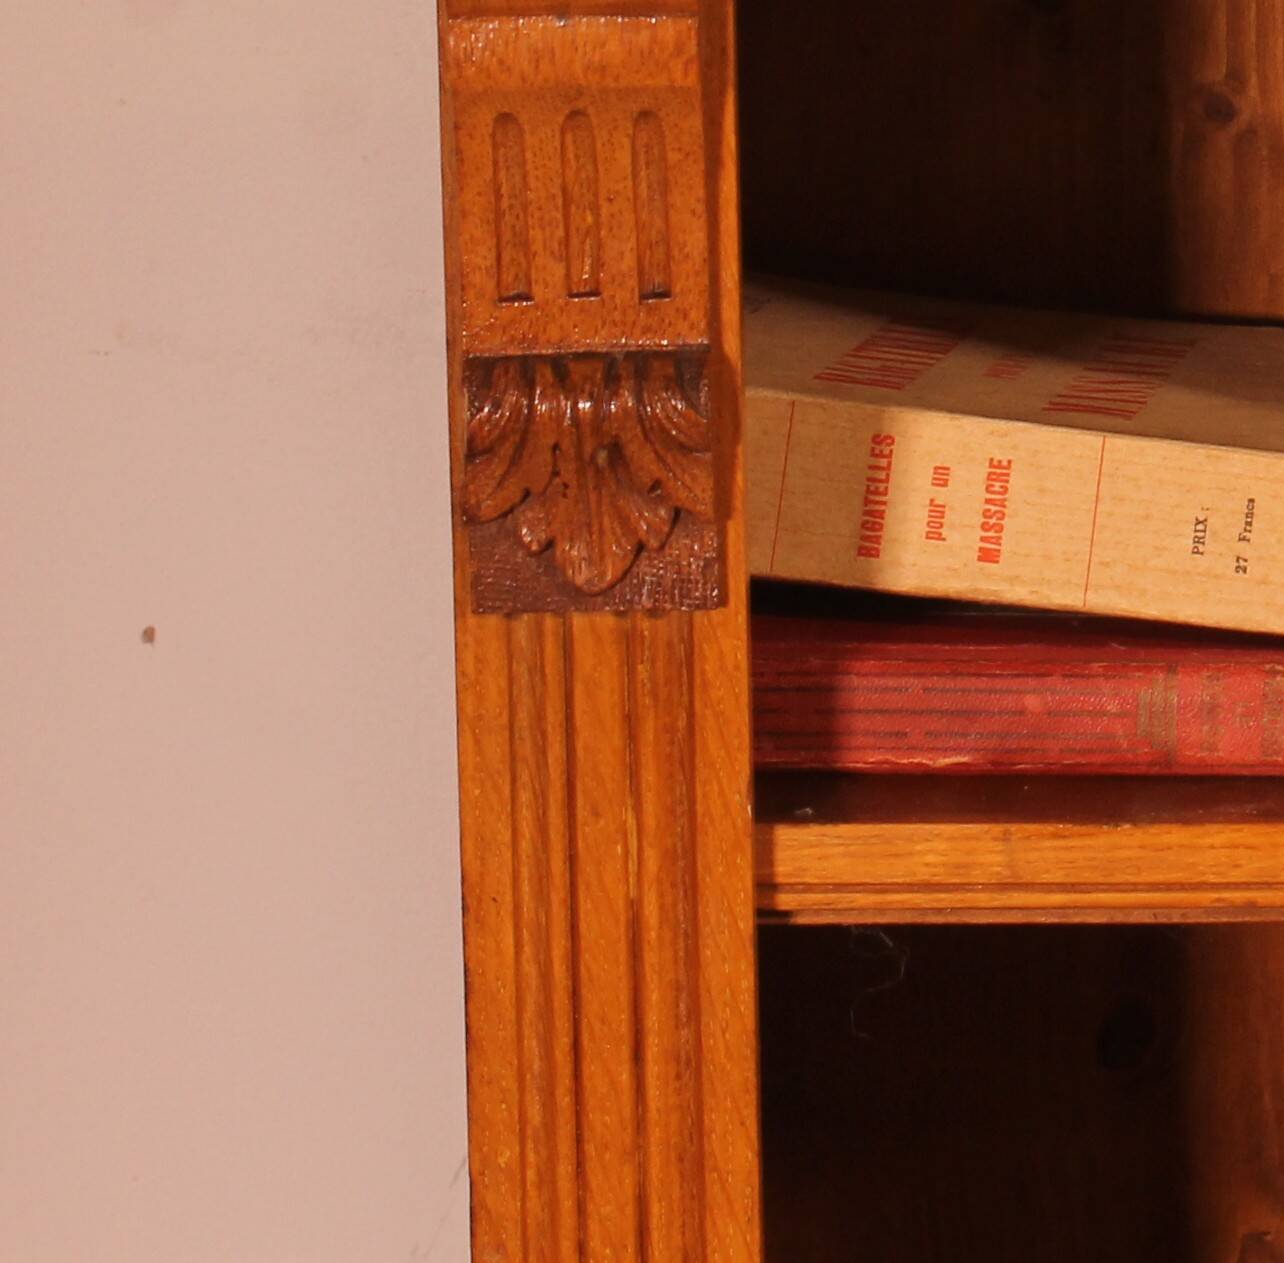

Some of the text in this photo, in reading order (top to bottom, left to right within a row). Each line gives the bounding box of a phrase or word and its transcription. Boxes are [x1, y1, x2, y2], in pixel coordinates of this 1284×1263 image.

[856, 433, 896, 559] BAGATELLES
[925, 465, 951, 542] pour un
[977, 457, 1013, 565] MASSACRE
[1235, 497, 1256, 575] 27 Francs
